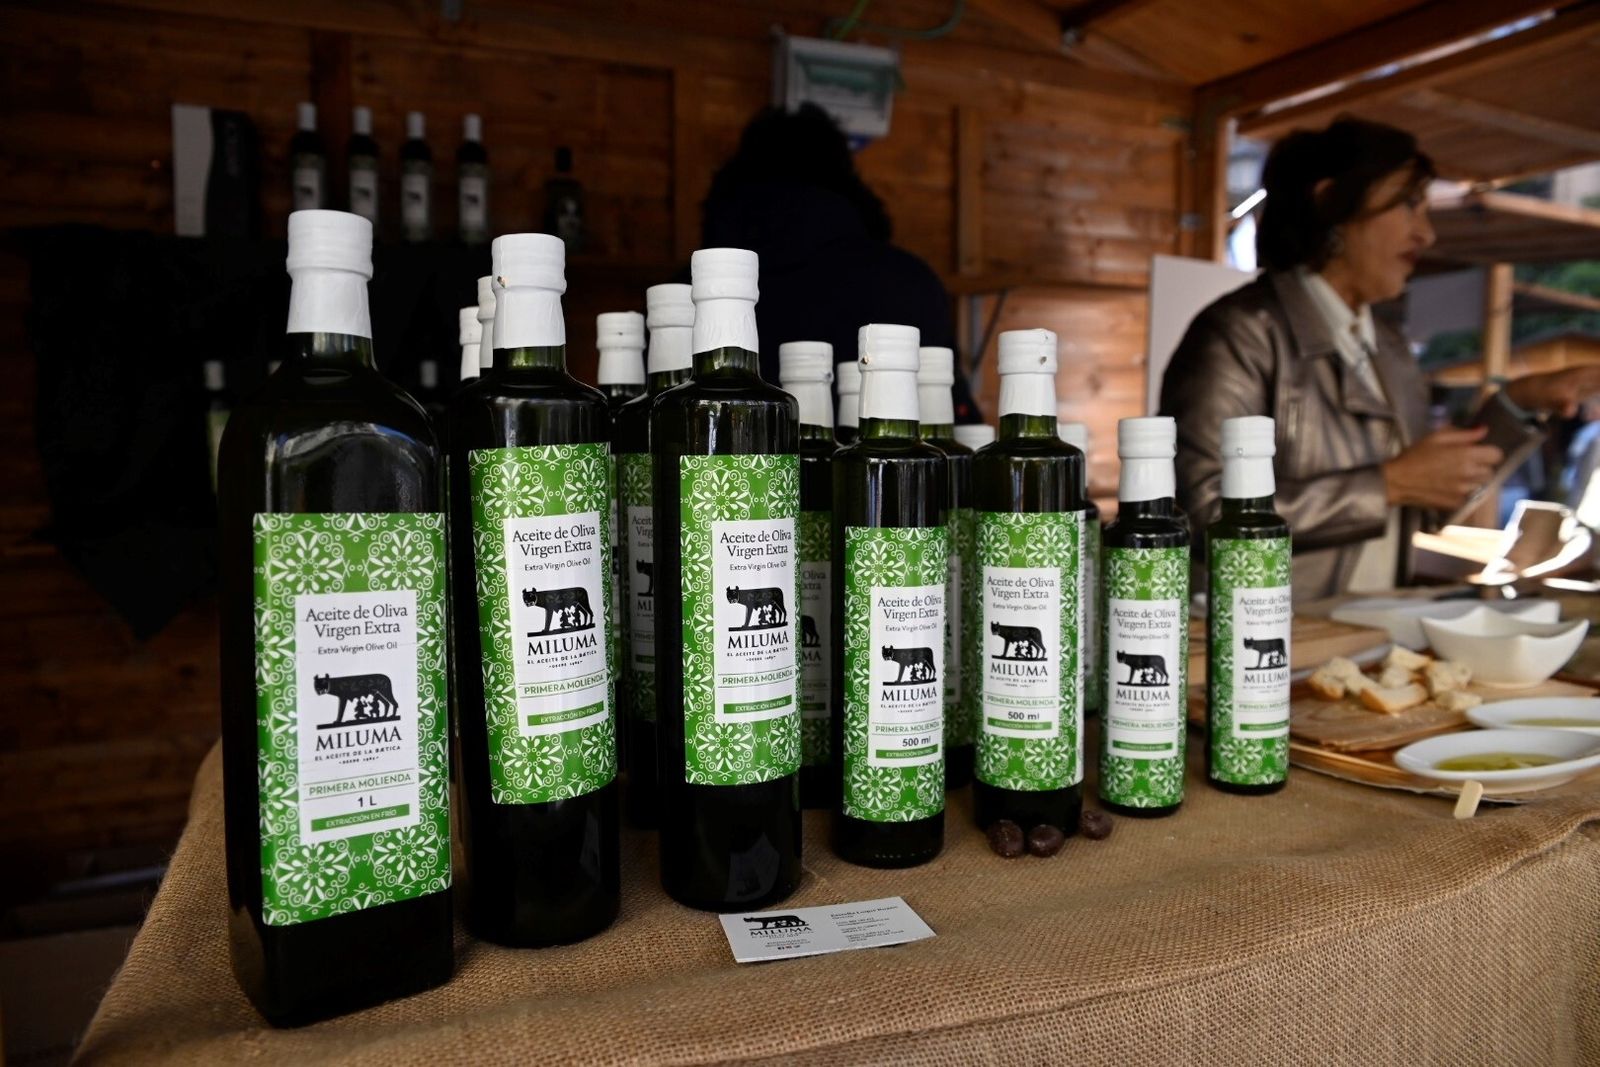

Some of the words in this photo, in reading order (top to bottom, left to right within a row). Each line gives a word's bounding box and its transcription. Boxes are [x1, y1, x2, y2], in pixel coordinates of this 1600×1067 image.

[632, 516, 653, 525] Aceit
[512, 529, 552, 542] Aceite
[554, 526, 568, 538] de
[570, 524, 596, 537] Oliva
[636, 526, 654, 538] Virg
[720, 532, 756, 544] Aceite
[758, 530, 770, 542] de
[772, 529, 792, 541] Oliva
[520, 544, 562, 558] Virgen
[564, 540, 592, 552] Extra
[727, 546, 764, 560] Virgen
[766, 544, 788, 555] Extra
[544, 562, 565, 570] Virgin
[566, 560, 581, 568] Olive
[803, 582, 822, 590] xtra
[987, 576, 1014, 587] Aceite
[1015, 577, 1027, 588] de
[1029, 578, 1054, 588] Oliva
[991, 587, 1020, 600] Virgen
[1023, 588, 1049, 598] Extra
[878, 597, 910, 607] Aceite
[912, 596, 923, 606] de
[924, 595, 942, 605] Oliva
[306, 608, 350, 622] Aceite
[350, 605, 370, 619] de
[373, 604, 408, 618] Oliva
[884, 609, 916, 622] Virgen
[919, 608, 938, 618] Extra
[1114, 608, 1139, 618] Aceite
[1141, 609, 1152, 618] de
[314, 624, 361, 640] Virgen
[364, 621, 400, 634] Extra
[528, 633, 598, 656] MILUMA
[728, 631, 789, 650] MILUMA
[318, 646, 338, 654] Extra
[340, 644, 364, 654] Virgin
[366, 642, 384, 651] Olive
[990, 662, 1048, 676] MILUMA
[722, 676, 760, 684] PRIMERA
[761, 670, 792, 682] MOLIENDA
[524, 684, 565, 694] PRIMERA
[568, 675, 604, 689] MOLIENDA
[882, 687, 937, 701] MILUMA
[1116, 689, 1170, 700] MILUMA
[540, 712, 578, 724] EXTRACCIÓN
[1008, 711, 1024, 720] 500
[1028, 712, 1040, 720] ml
[316, 726, 402, 752] MILUMA
[902, 738, 919, 747] 500
[922, 736, 931, 744] ml
[326, 752, 350, 760] ACEITE
[309, 782, 356, 796] PRIMERA
[358, 773, 411, 788] MOLIENDA
[358, 797, 363, 807] 1
[370, 796, 377, 806] L
[750, 926, 812, 936] MILUMA
